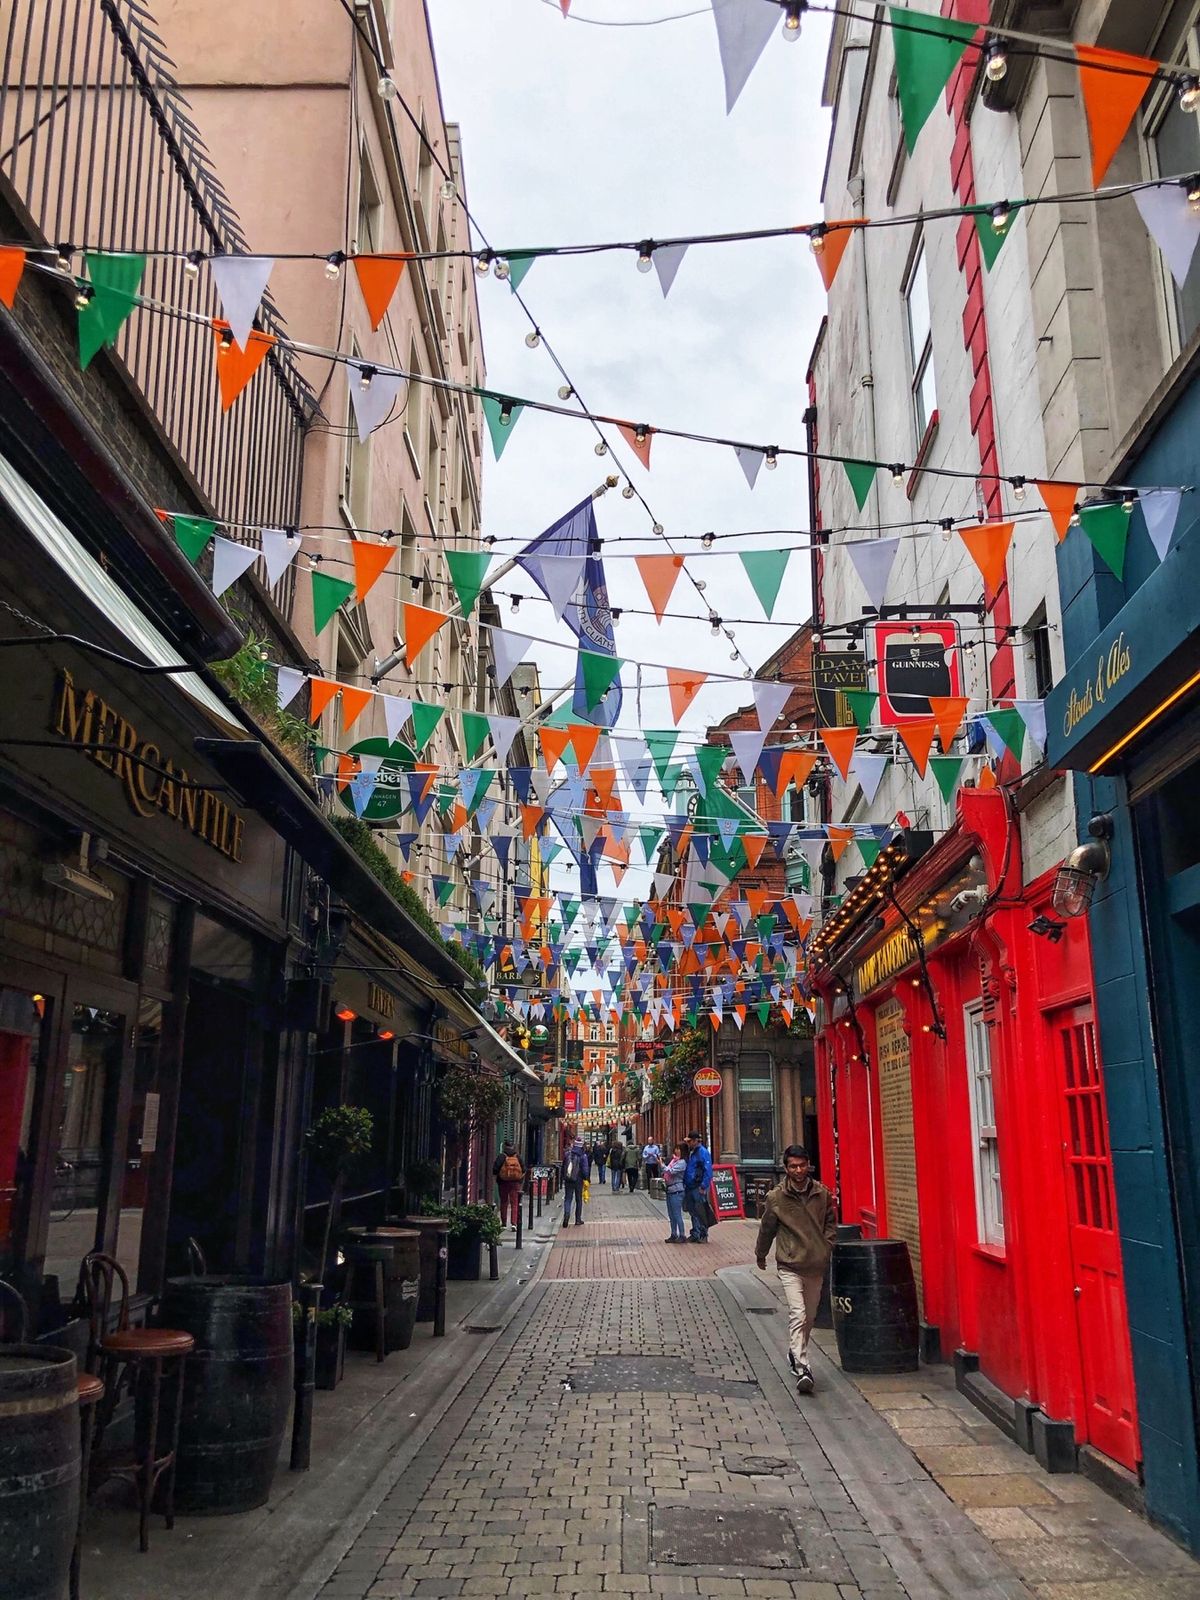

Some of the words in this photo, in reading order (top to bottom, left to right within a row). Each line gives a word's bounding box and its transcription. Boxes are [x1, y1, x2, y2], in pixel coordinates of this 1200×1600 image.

[585, 626, 615, 651] CLIATH
[892, 660, 940, 669] GUINNESS
[1063, 687, 1093, 737] Stouts
[1096, 655, 1106, 703] &
[1106, 631, 1130, 689] Ales
[56, 666, 246, 865] MERCANTILE
